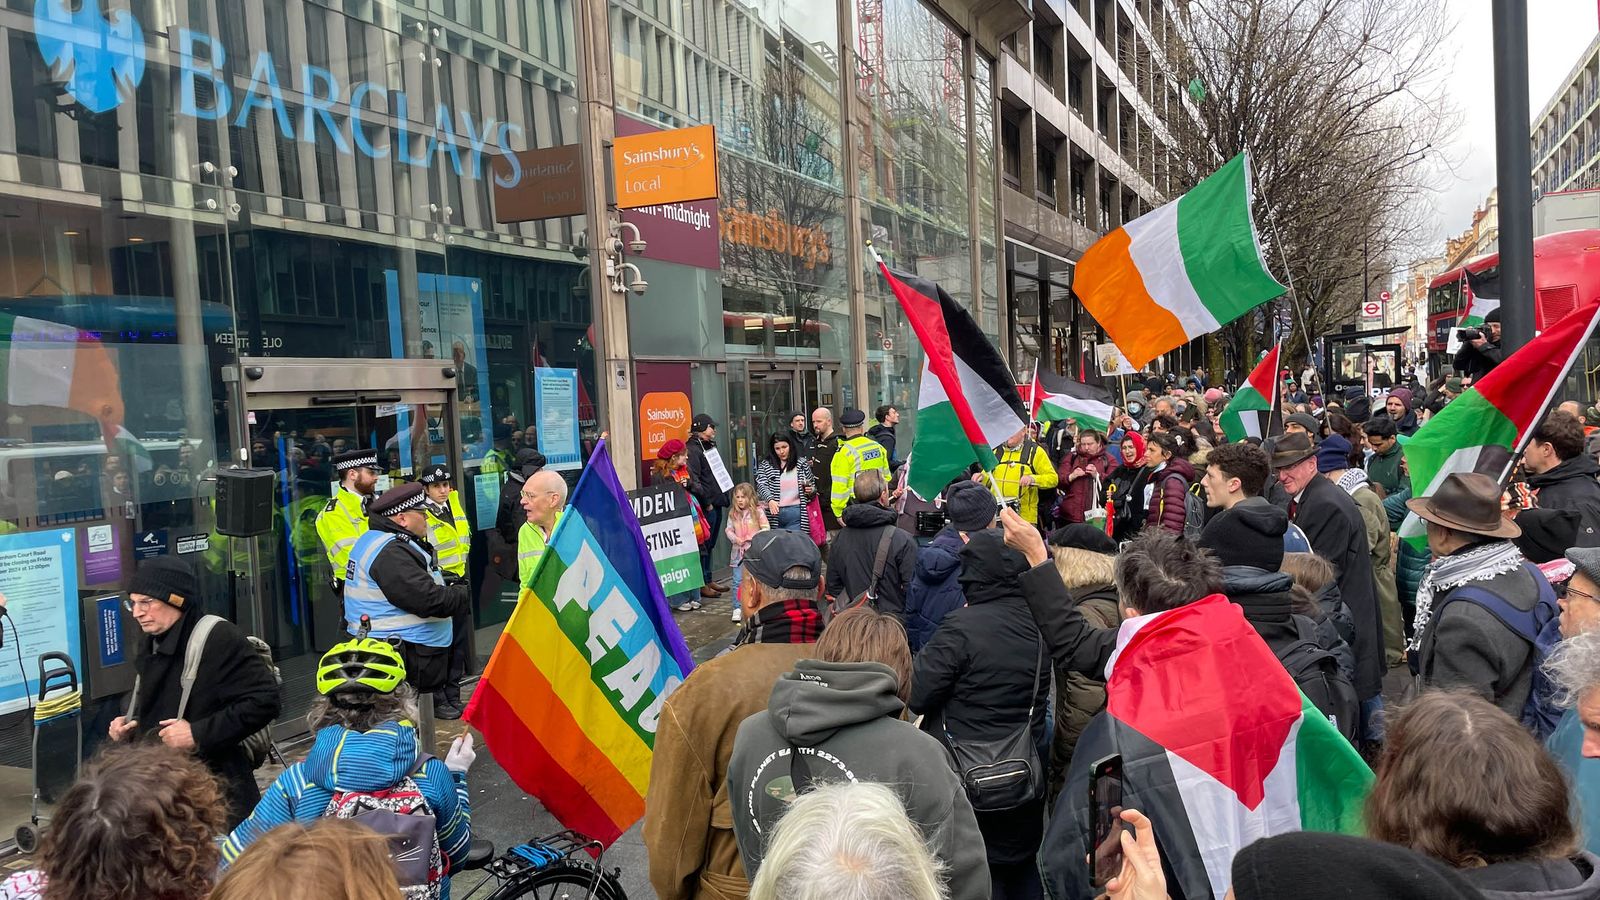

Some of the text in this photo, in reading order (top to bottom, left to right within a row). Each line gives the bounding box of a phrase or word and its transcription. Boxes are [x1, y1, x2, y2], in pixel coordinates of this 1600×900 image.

[177, 27, 523, 189] BARCLAYS
[623, 143, 701, 166] Sainsbury's
[625, 174, 662, 195] Local
[646, 407, 685, 422] Sainsbury's
[648, 429, 667, 444] Local
[628, 490, 676, 519] MDEN
[645, 528, 683, 553] STINE
[660, 568, 692, 588] paign
[553, 538, 682, 733] PEAC
[751, 751, 777, 789] PLANET
